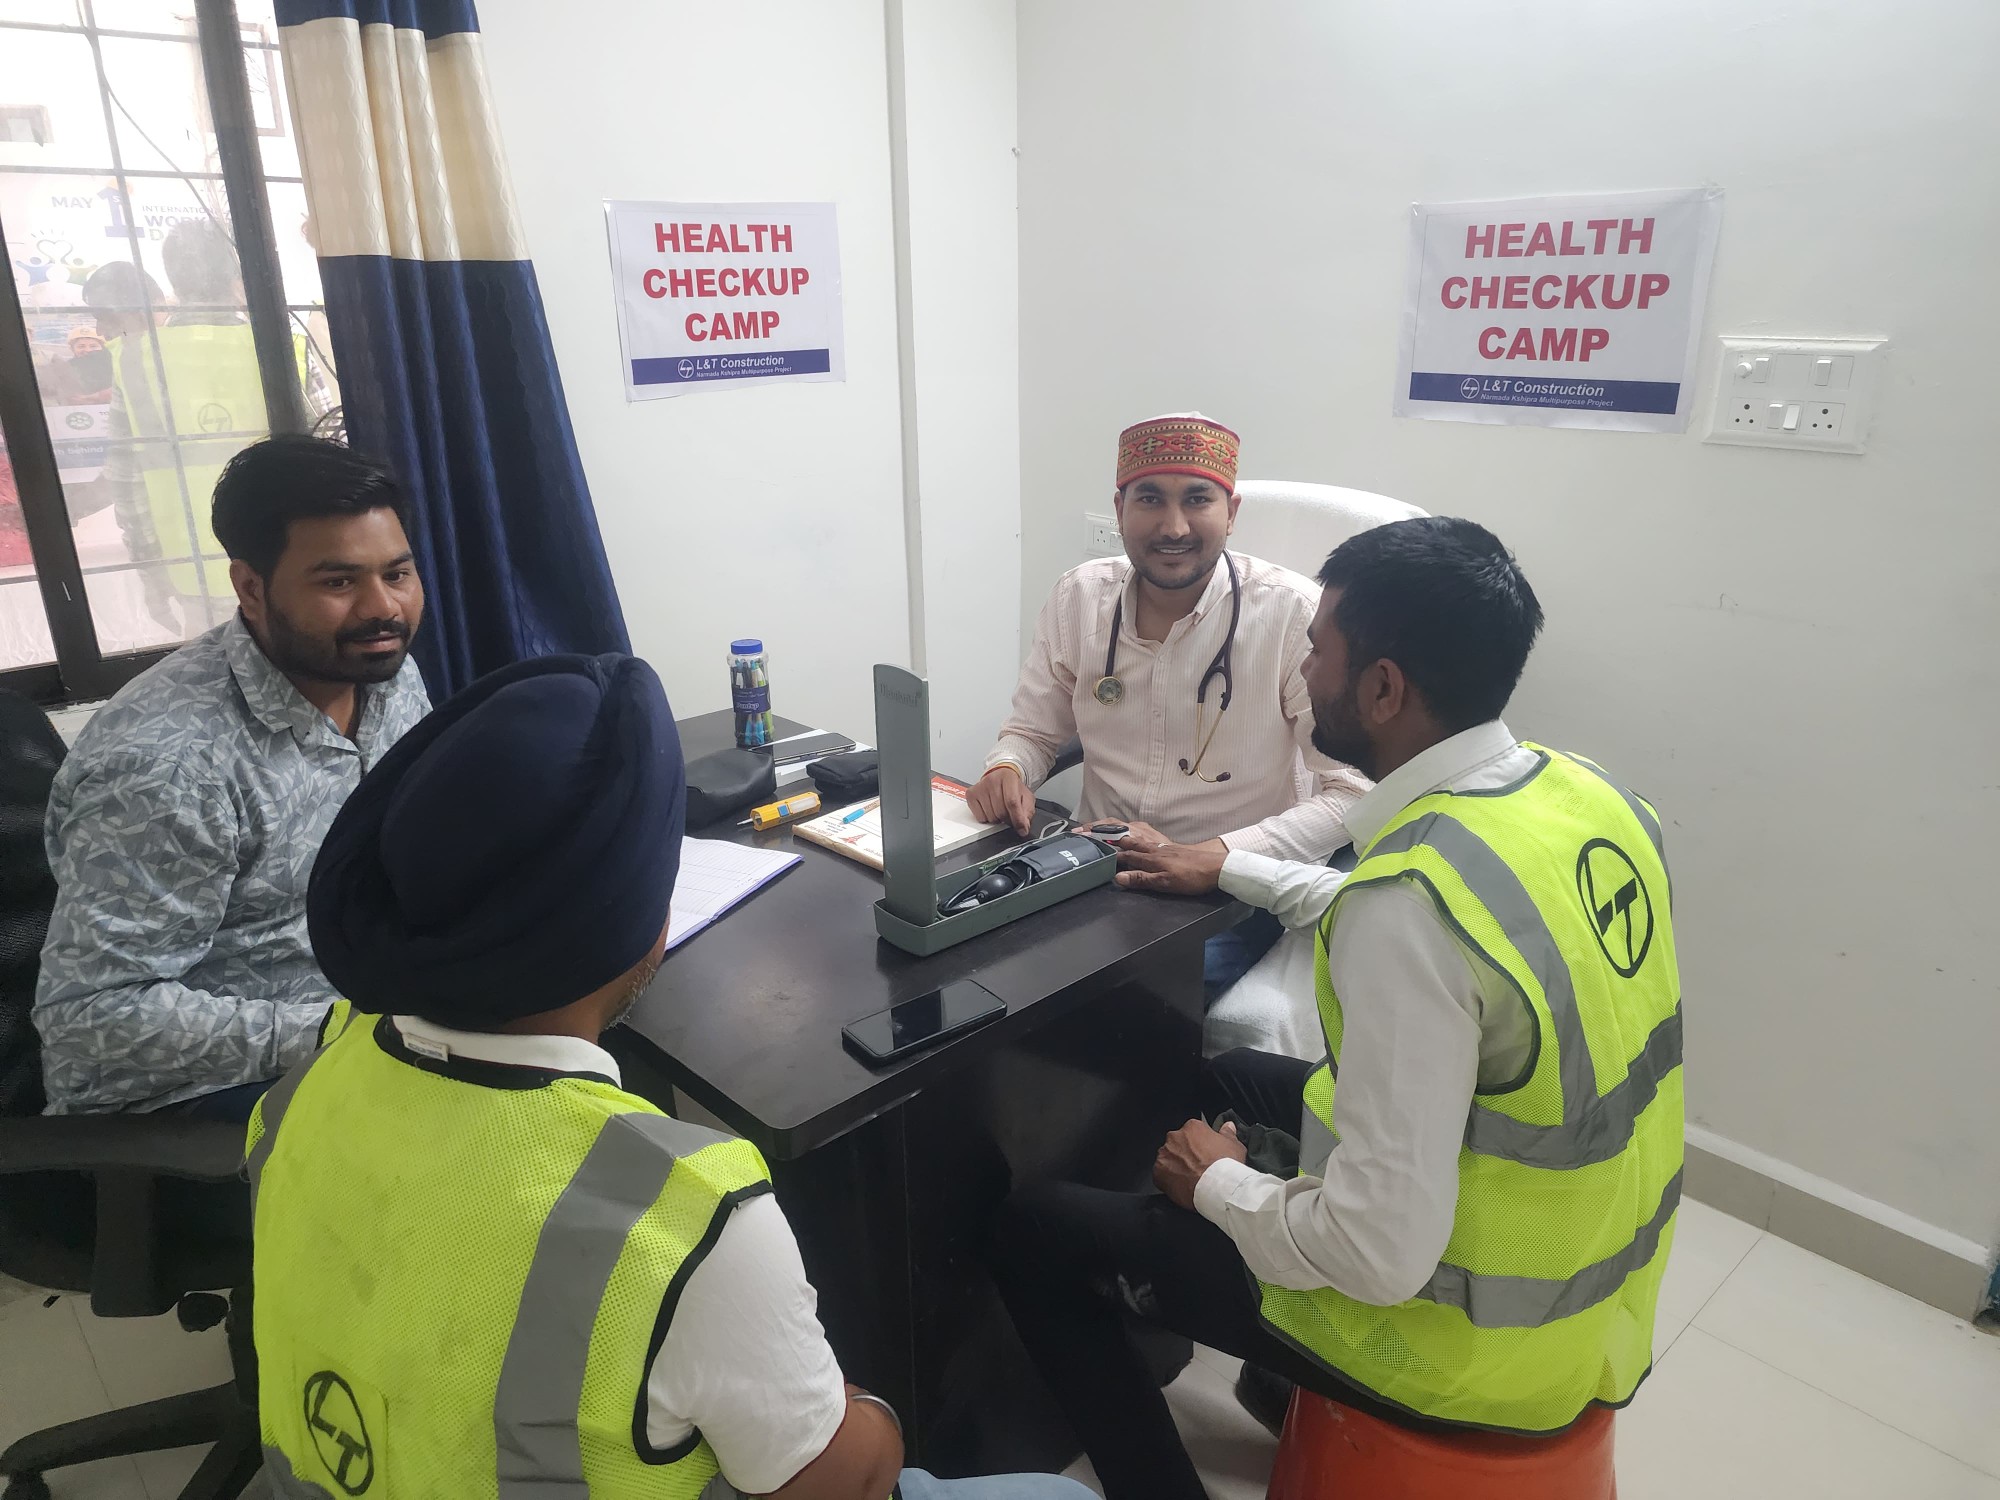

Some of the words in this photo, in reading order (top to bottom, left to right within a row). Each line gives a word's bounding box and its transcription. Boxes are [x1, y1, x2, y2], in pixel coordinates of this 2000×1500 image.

[51, 196, 93, 209] MAY
[654, 222, 794, 253] HEALTH
[1464, 217, 1656, 259] HEALTH
[642, 267, 810, 299] CHECKUP
[1440, 273, 1671, 310] CHECKUP
[684, 310, 780, 342] CAMP
[1477, 326, 1610, 363] CAMP
[696, 358, 718, 370] L&T
[720, 355, 784, 369] Construction
[696, 371, 720, 379] Narmada
[741, 368, 773, 376] Multipurpose
[774, 366, 792, 374] Project
[1480, 393, 1510, 401] Narmada
[1511, 394, 1538, 404] Kshipra
[1538, 396, 1586, 406] Multipurpose
[1586, 398, 1614, 408] Project
[1482, 379, 1511, 392] L&T
[1514, 380, 1605, 397] Construction
